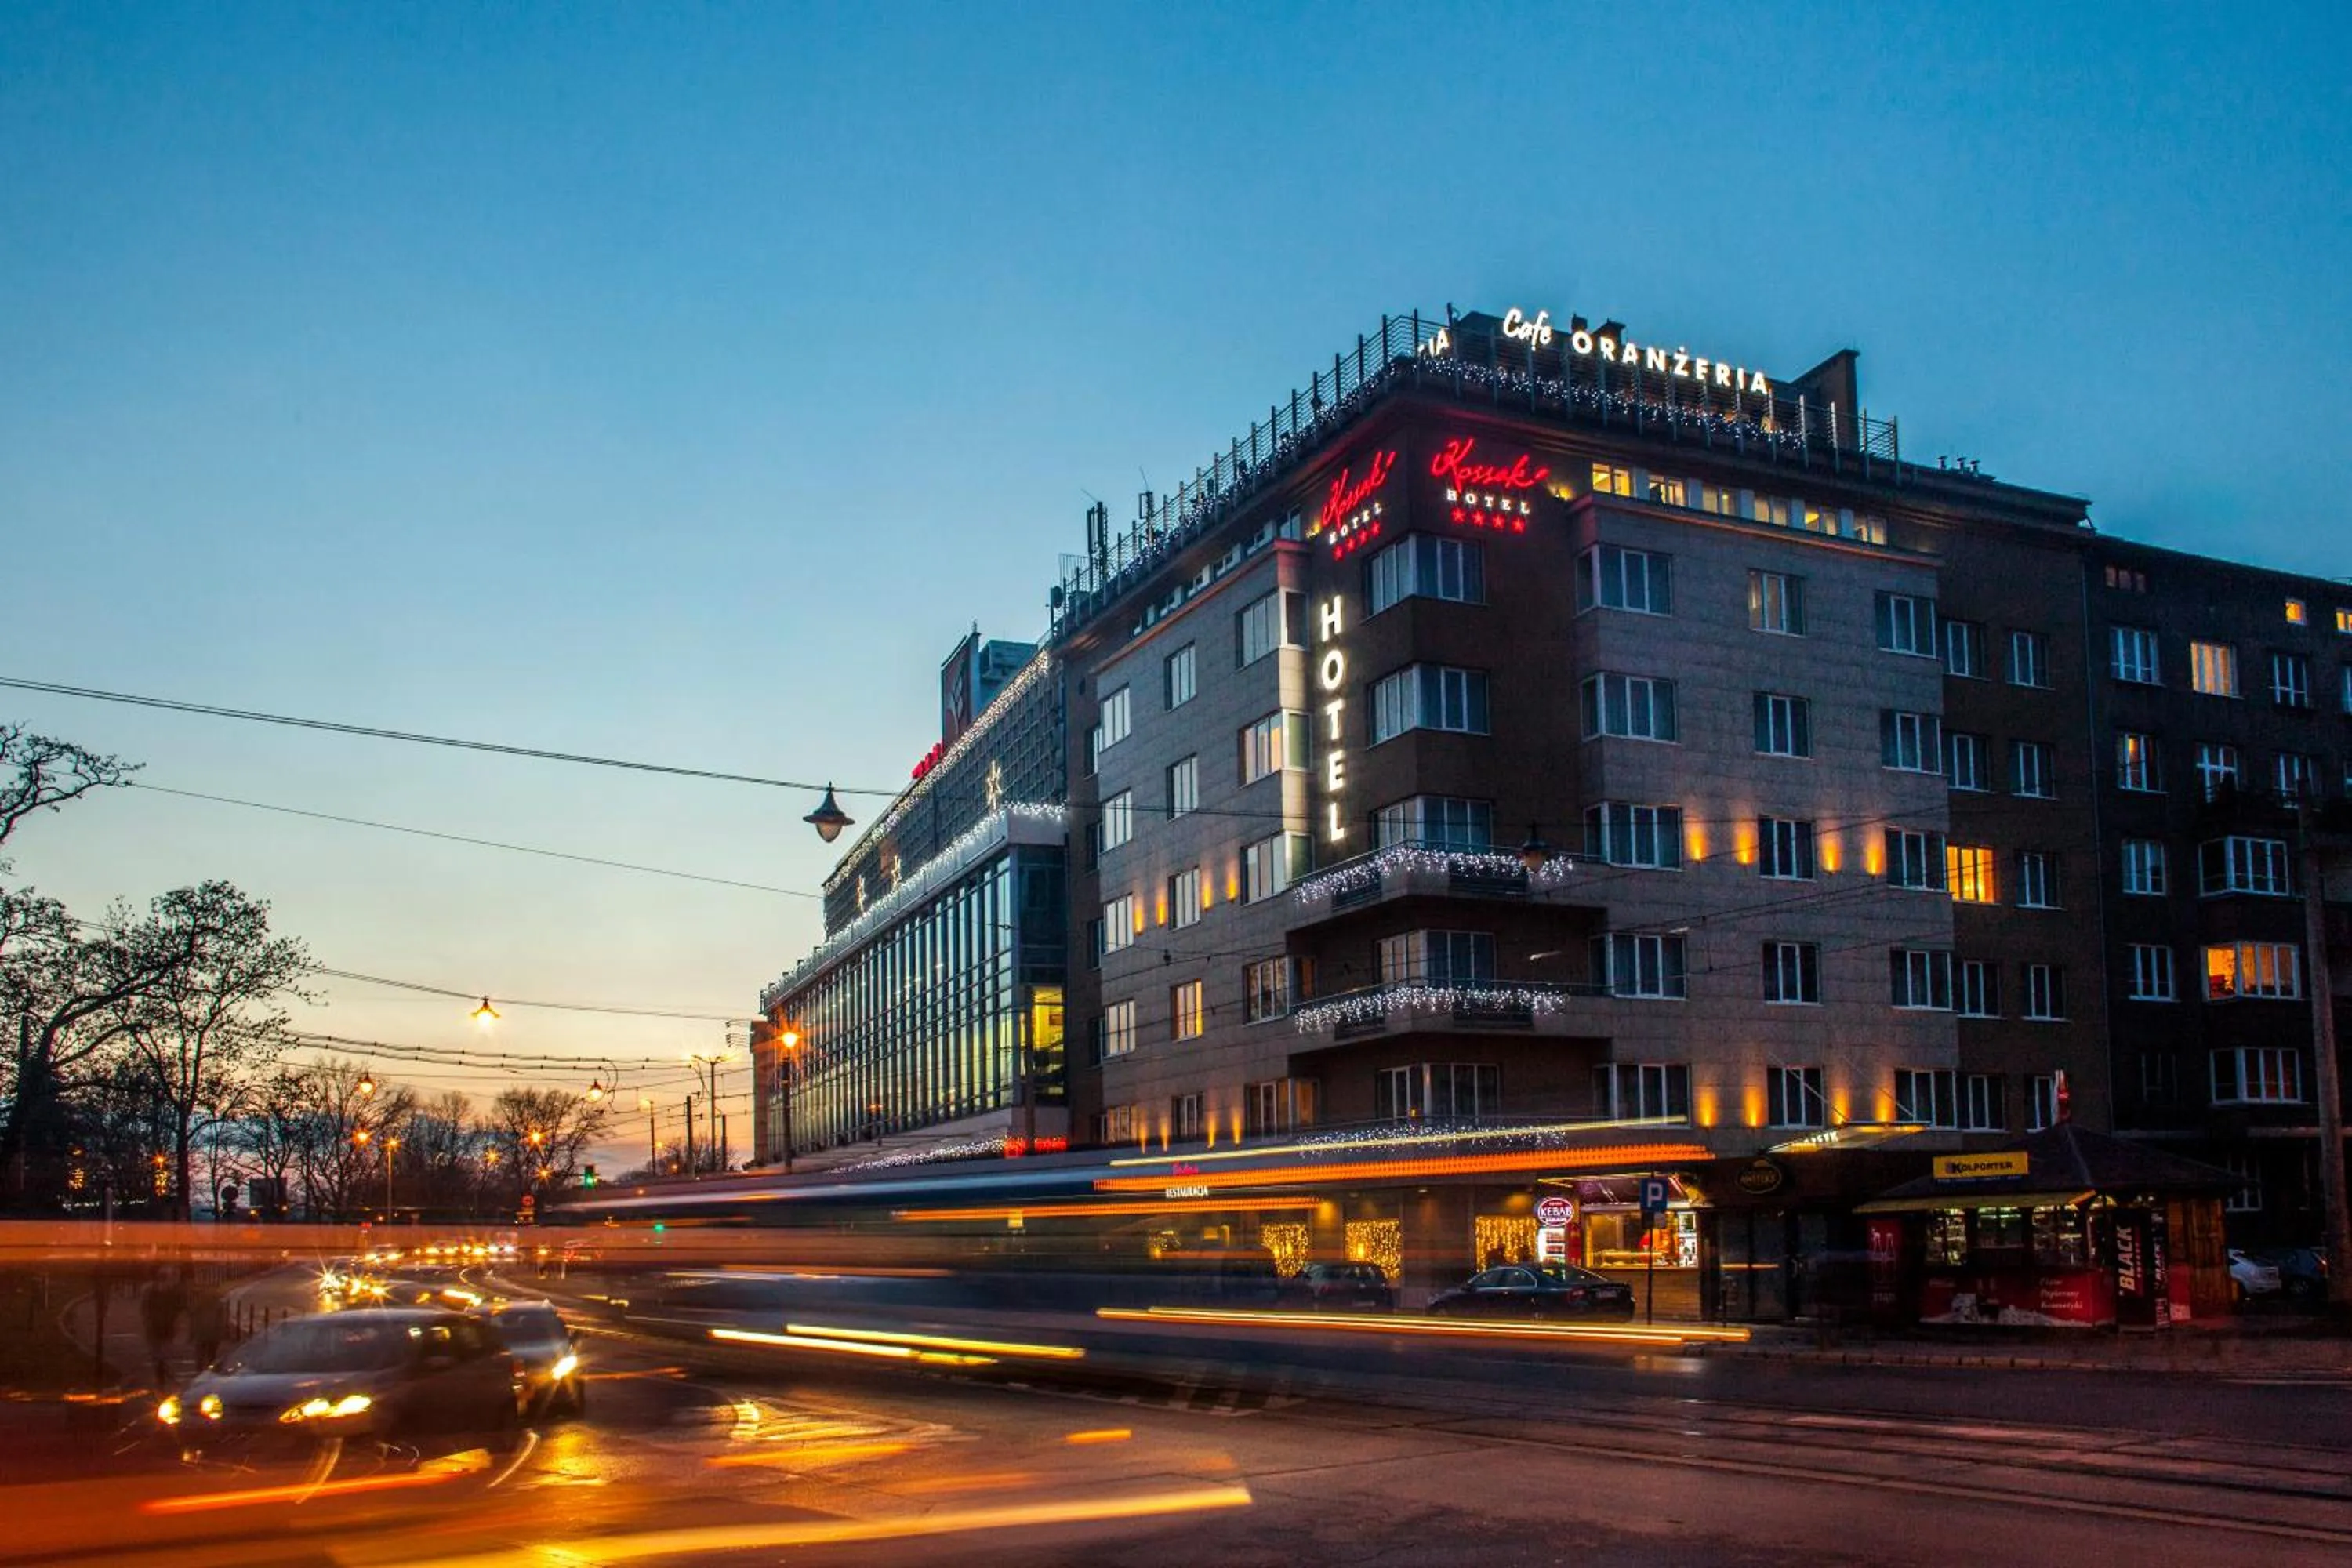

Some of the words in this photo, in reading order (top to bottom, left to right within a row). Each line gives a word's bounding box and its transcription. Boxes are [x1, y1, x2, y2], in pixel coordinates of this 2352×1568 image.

[1571, 330, 1768, 394] ORANŻERIA
[1446, 488, 1530, 515] HOTEL
[1329, 502, 1382, 545] HOTEL
[1321, 594, 1345, 841] HOTEL
[1539, 1206, 1572, 1217] KEBAB
[1648, 1182, 1662, 1207] P
[2117, 1224, 2135, 1290] BLACK
